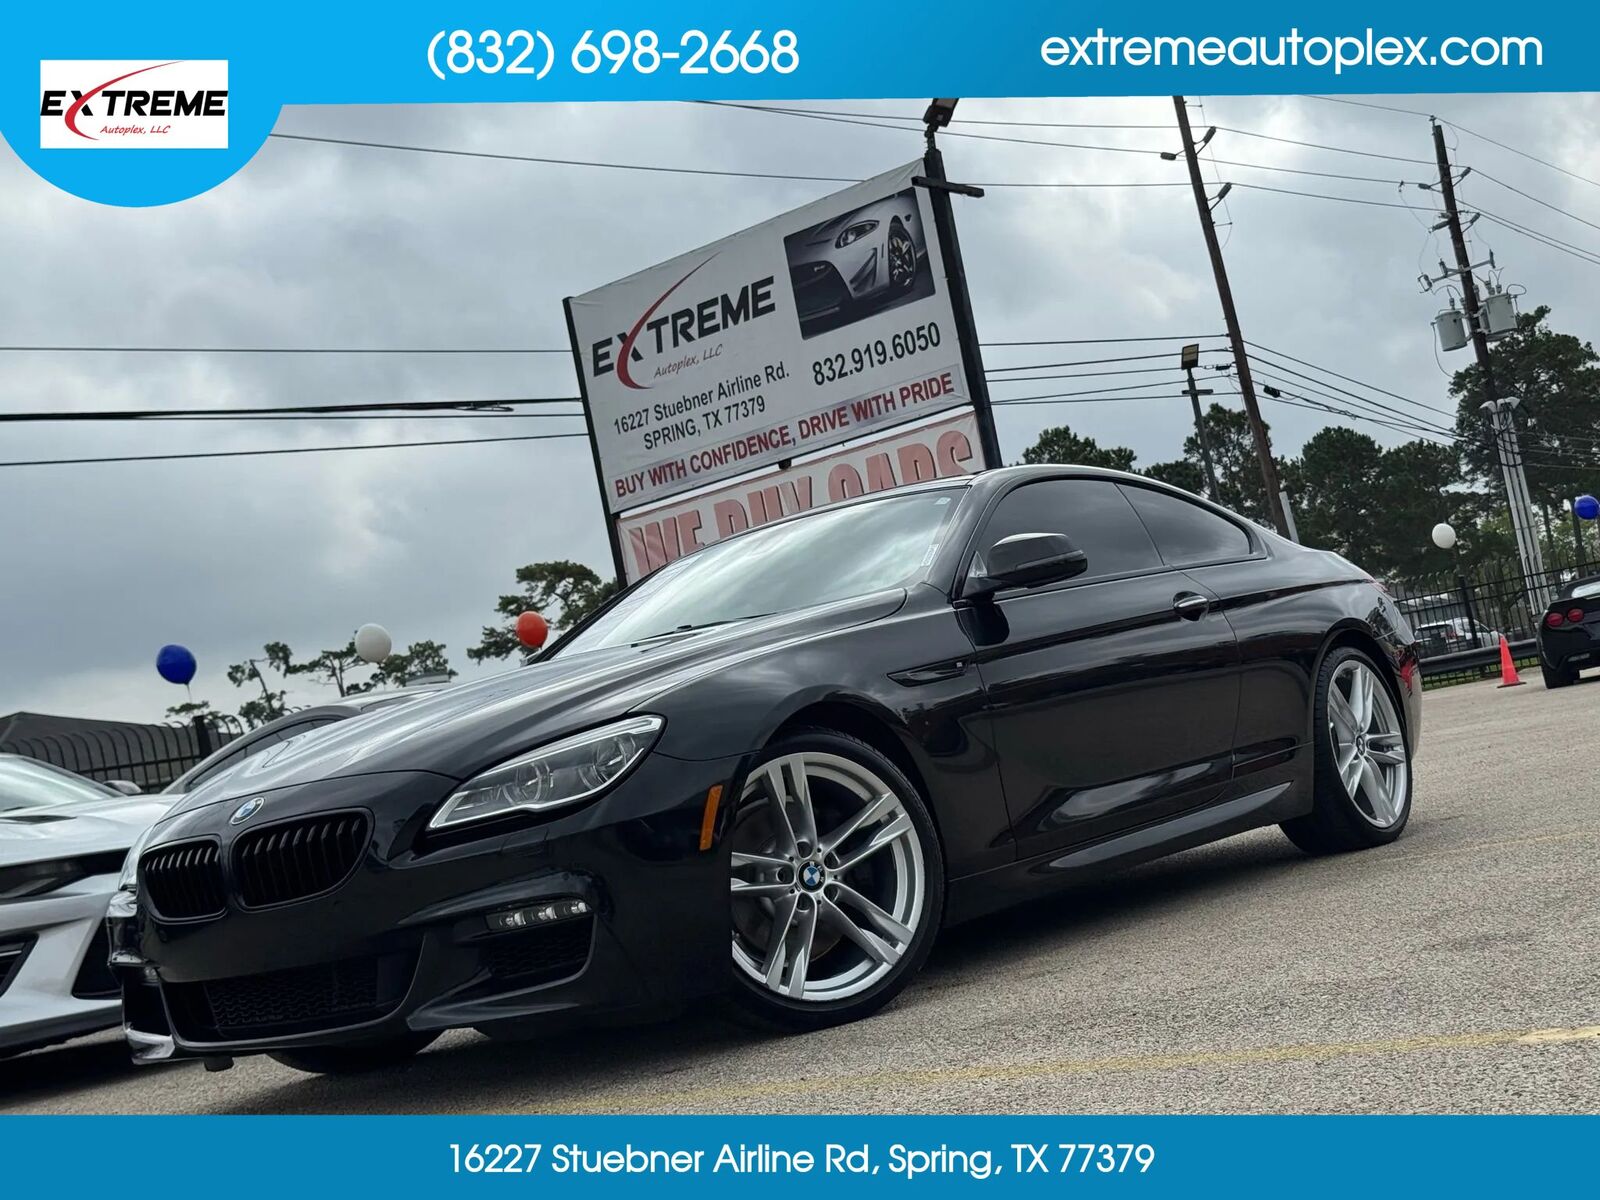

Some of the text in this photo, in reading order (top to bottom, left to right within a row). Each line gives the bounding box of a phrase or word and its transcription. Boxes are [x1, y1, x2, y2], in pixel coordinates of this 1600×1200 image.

[592, 275, 776, 377] EXTREME
[812, 321, 941, 386] 832.919.6050
[653, 343, 723, 379] Autoplex, LLC
[614, 361, 790, 435] 16227 Stuebner Airline Rd.
[643, 394, 766, 450] SPRING, TX 77379
[615, 372, 955, 498] BUY WITH CONFIDENCE, DRIVE WITH PRIDE
